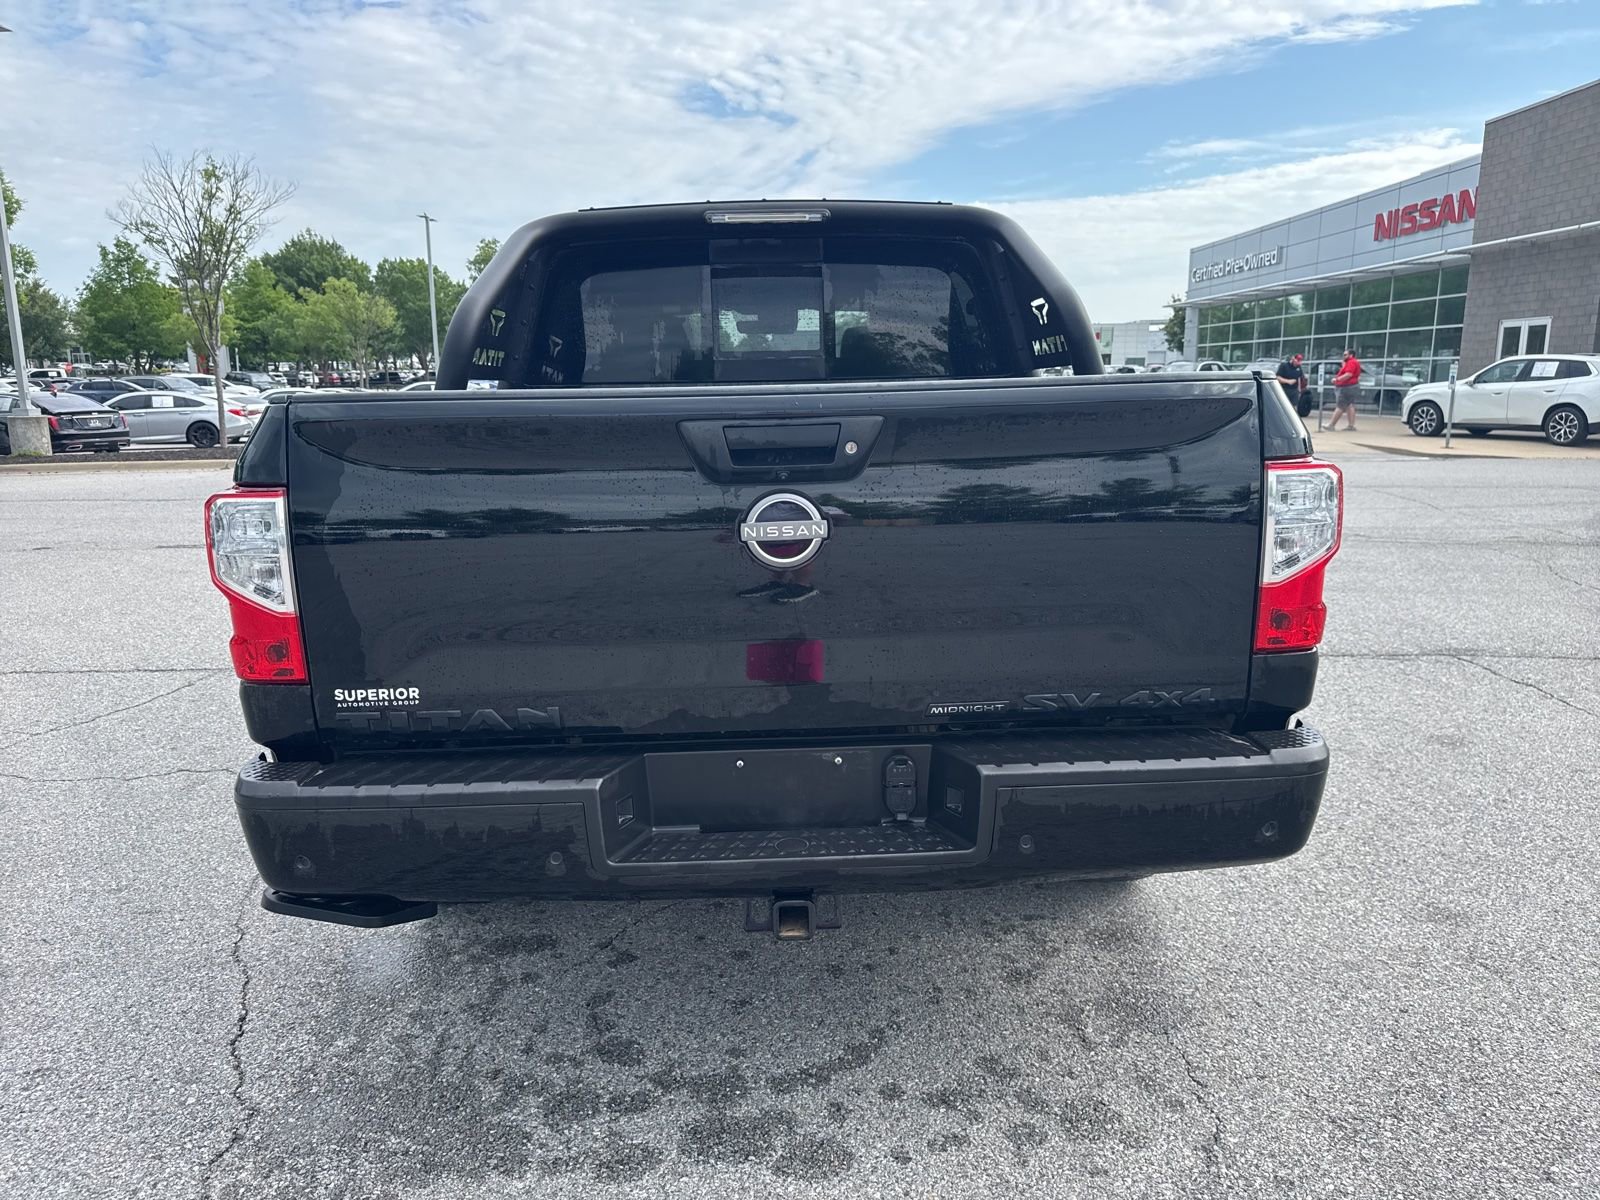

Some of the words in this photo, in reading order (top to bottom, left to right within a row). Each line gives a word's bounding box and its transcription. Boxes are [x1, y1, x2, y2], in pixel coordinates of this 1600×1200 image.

[1373, 186, 1479, 242] NISSAN
[1191, 259, 1224, 283] Certified
[1225, 245, 1278, 276] Pre-Owned
[744, 524, 824, 538] NISSAN
[334, 687, 420, 702] SUPERIOR
[1023, 692, 1101, 711] SV
[930, 704, 1006, 715] MIDNIGHT
[335, 706, 563, 733] TITAN
